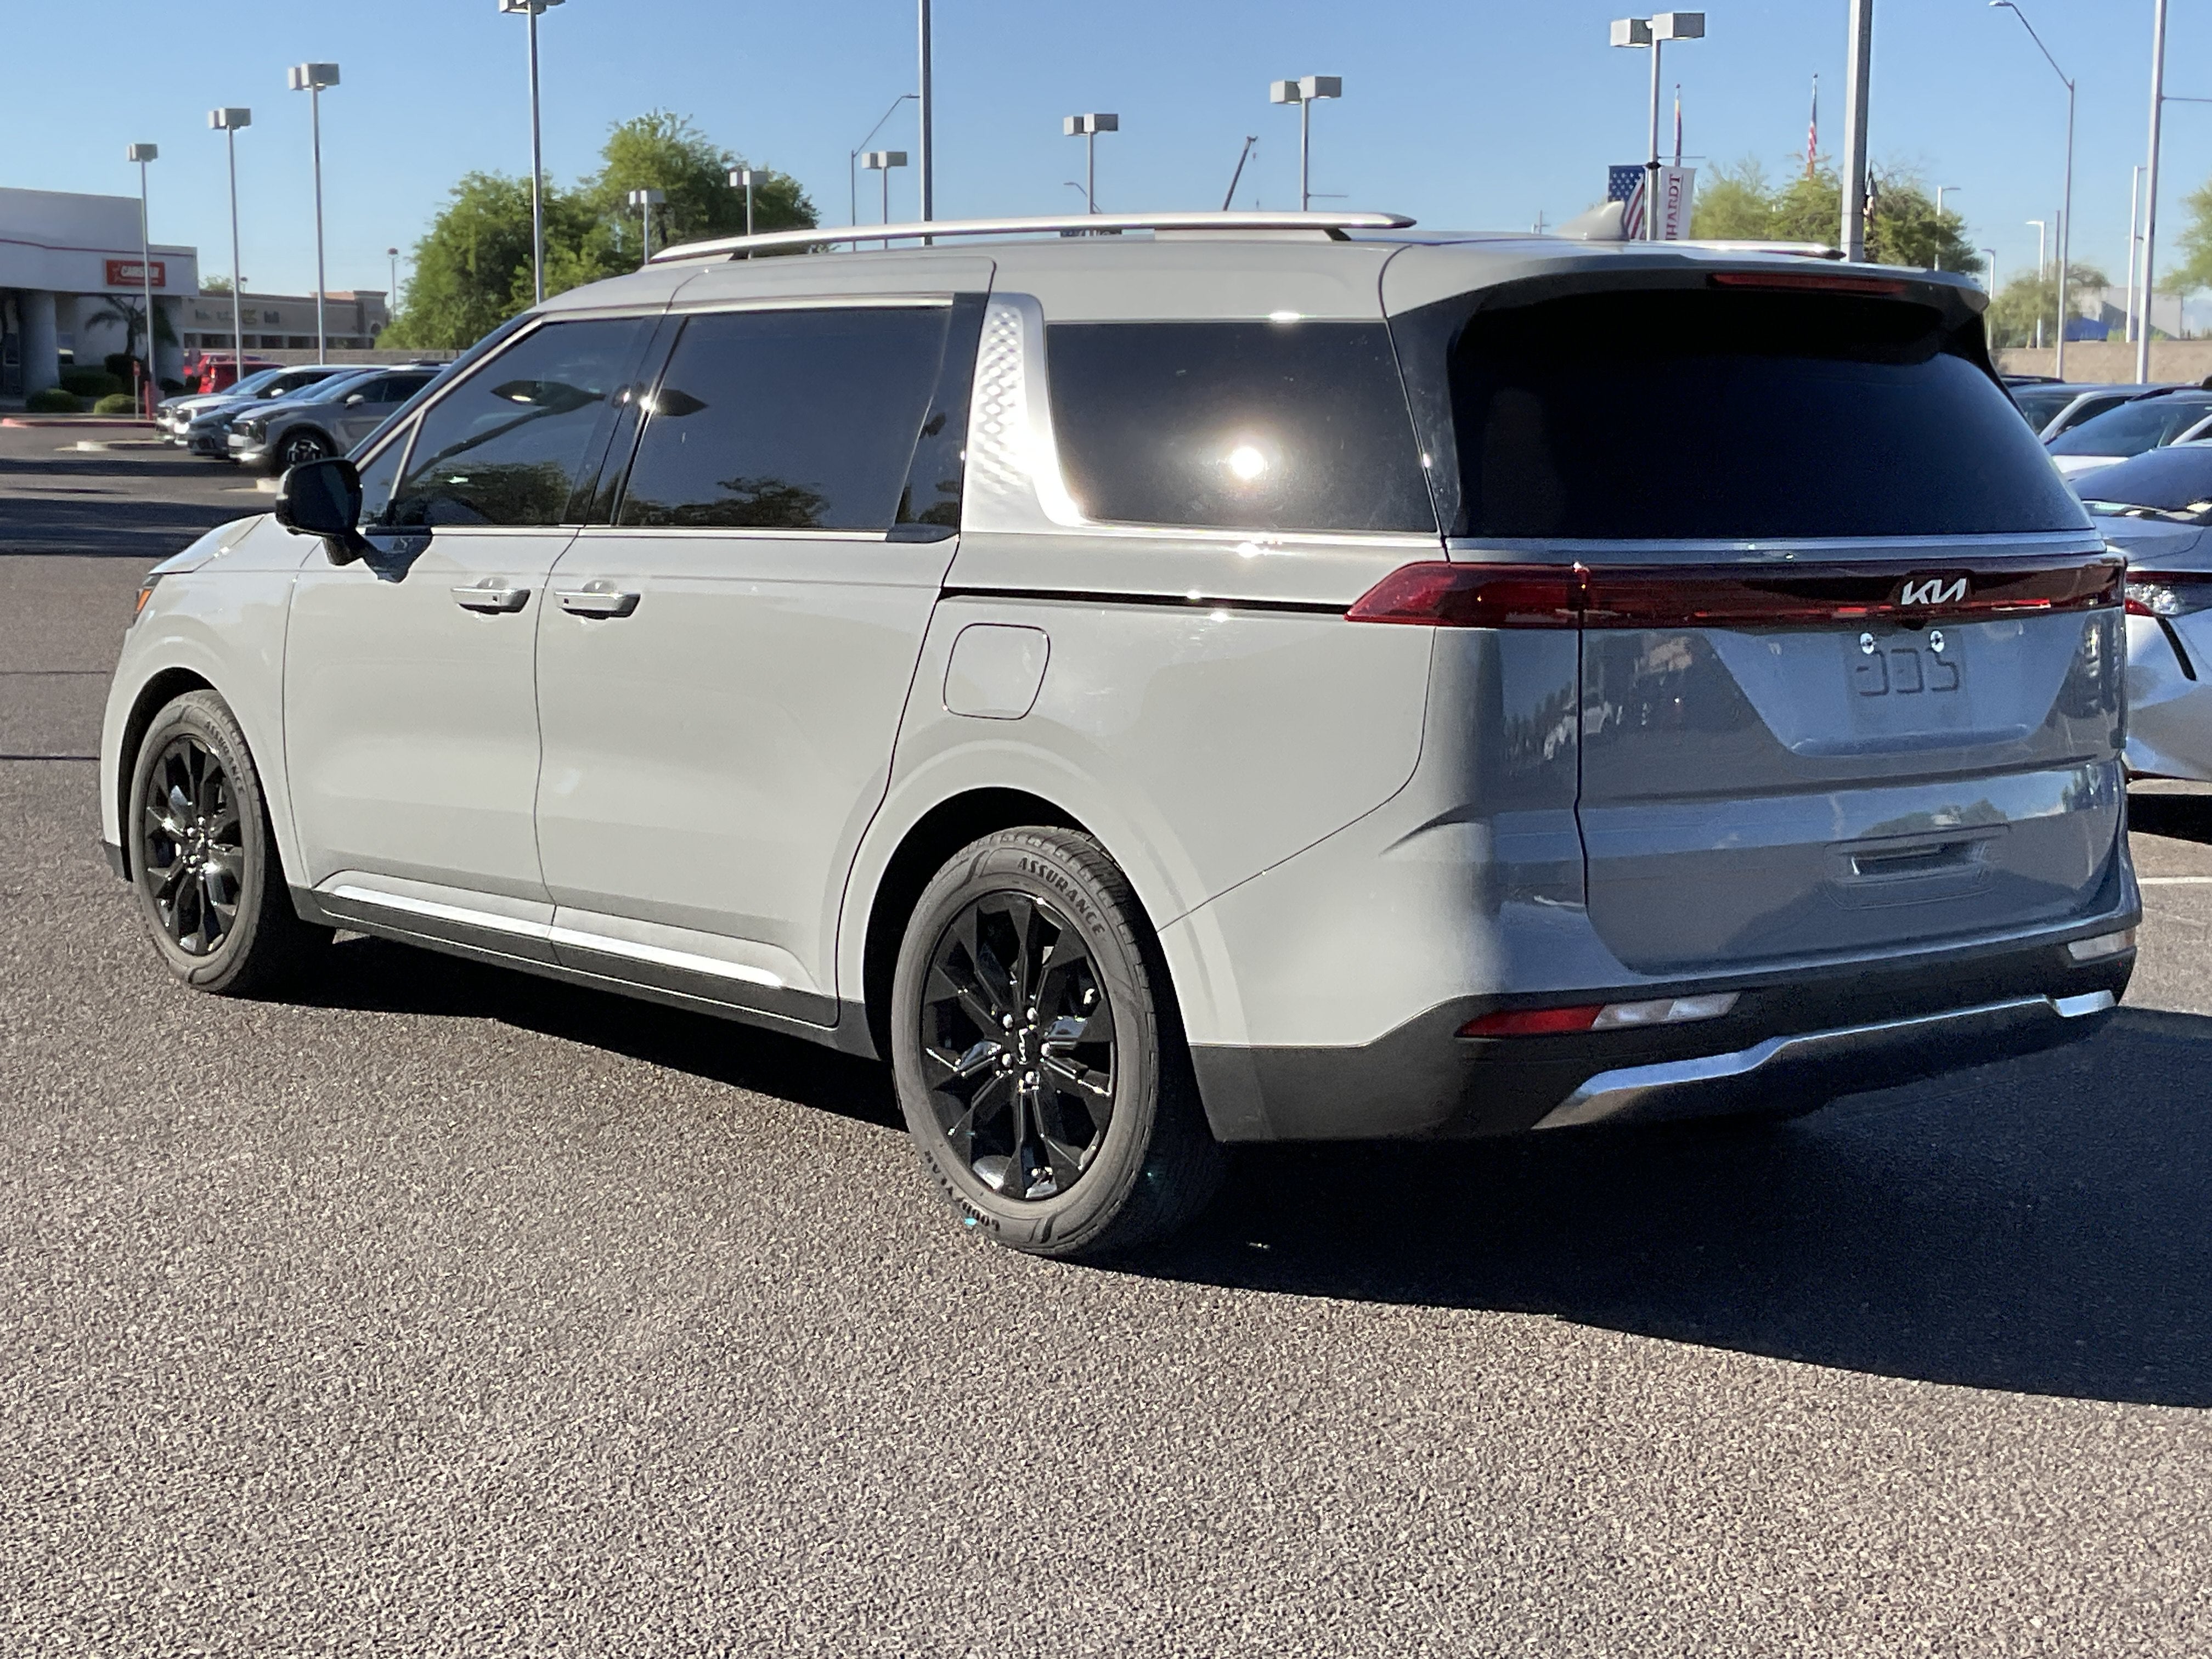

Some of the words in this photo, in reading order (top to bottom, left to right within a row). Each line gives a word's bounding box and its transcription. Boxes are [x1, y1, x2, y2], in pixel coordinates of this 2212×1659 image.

[1666, 173, 1680, 240] HARDT
[1901, 577, 1967, 605] KIA
[1018, 857, 1105, 934] ASSURANCE
